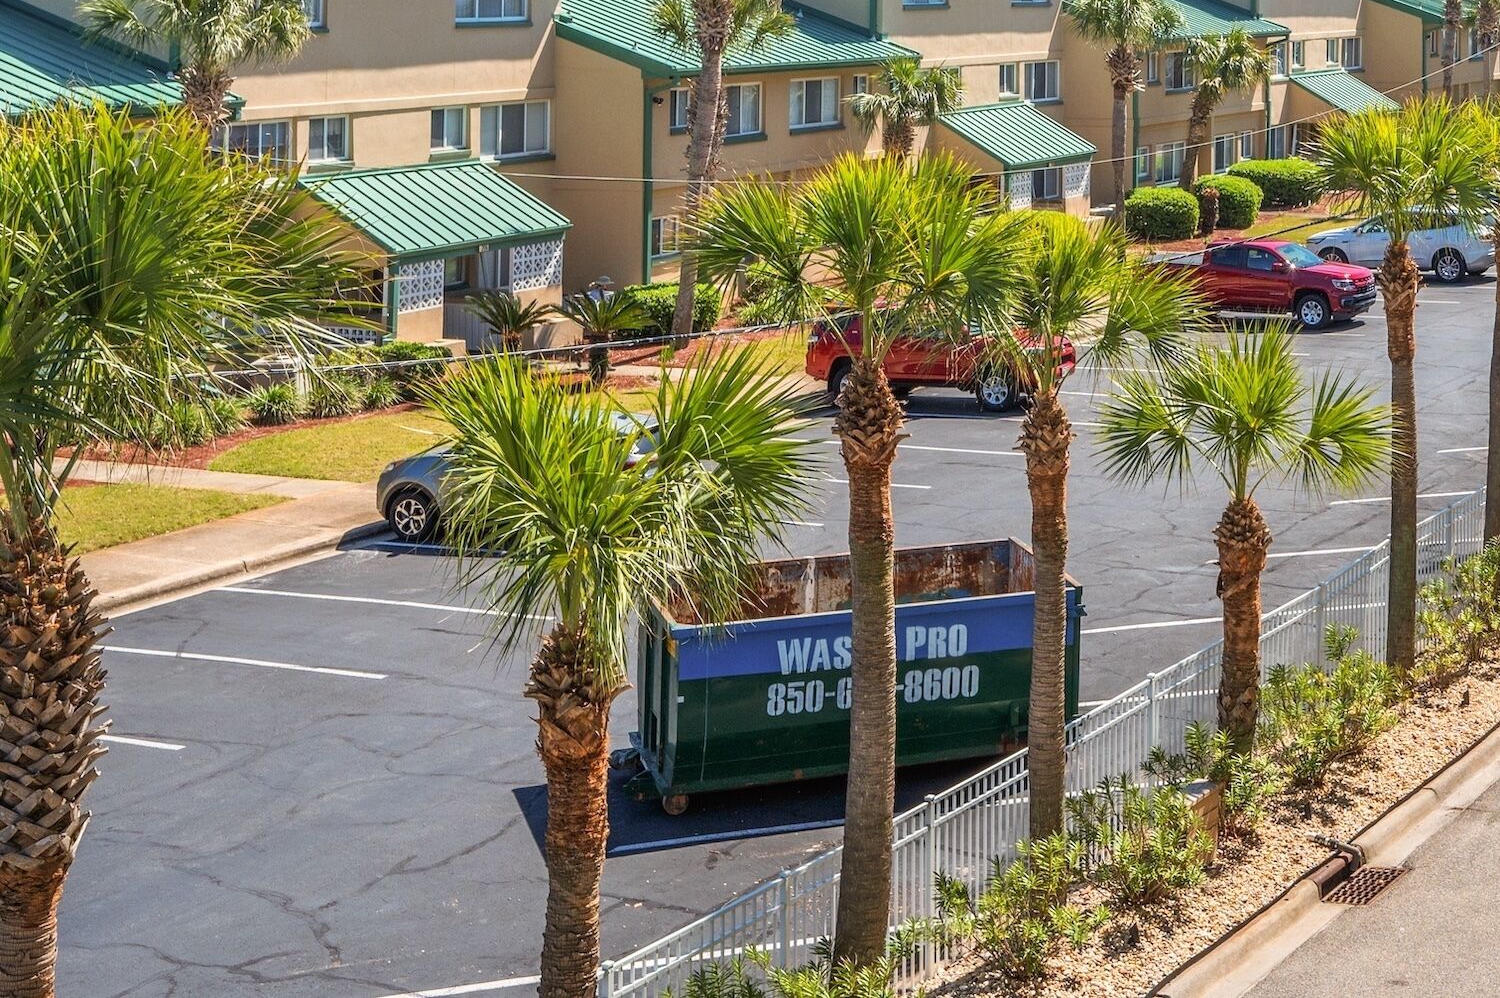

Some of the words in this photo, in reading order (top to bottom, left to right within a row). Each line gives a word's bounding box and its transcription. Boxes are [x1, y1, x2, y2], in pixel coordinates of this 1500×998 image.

[777, 636, 852, 675] WAS
[905, 624, 967, 661] PRO
[767, 665, 979, 716] 850-6-8600
